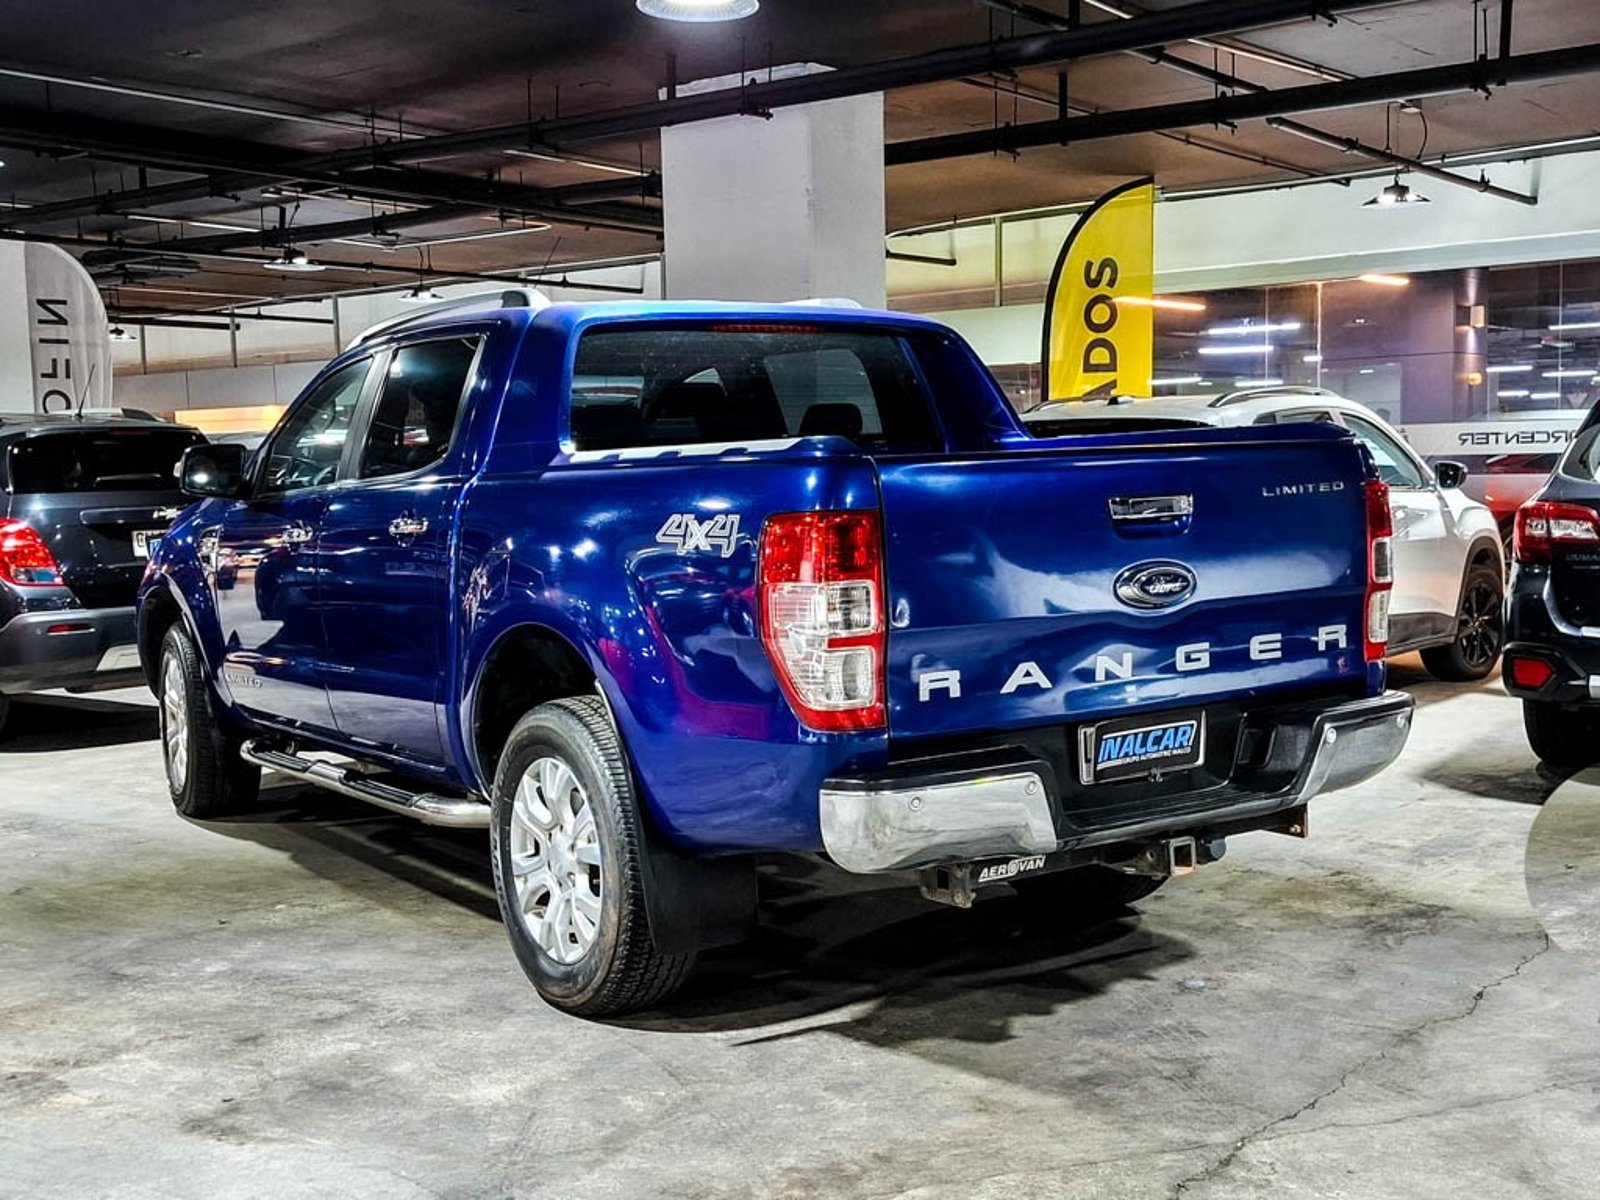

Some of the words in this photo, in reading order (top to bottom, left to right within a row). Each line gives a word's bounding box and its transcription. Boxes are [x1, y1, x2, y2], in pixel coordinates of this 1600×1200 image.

[1262, 481, 1344, 497] LIMITED
[918, 623, 1348, 702] RANGER
[1098, 726, 1192, 763] INALCAR
[979, 855, 1046, 881] AEROVAN
